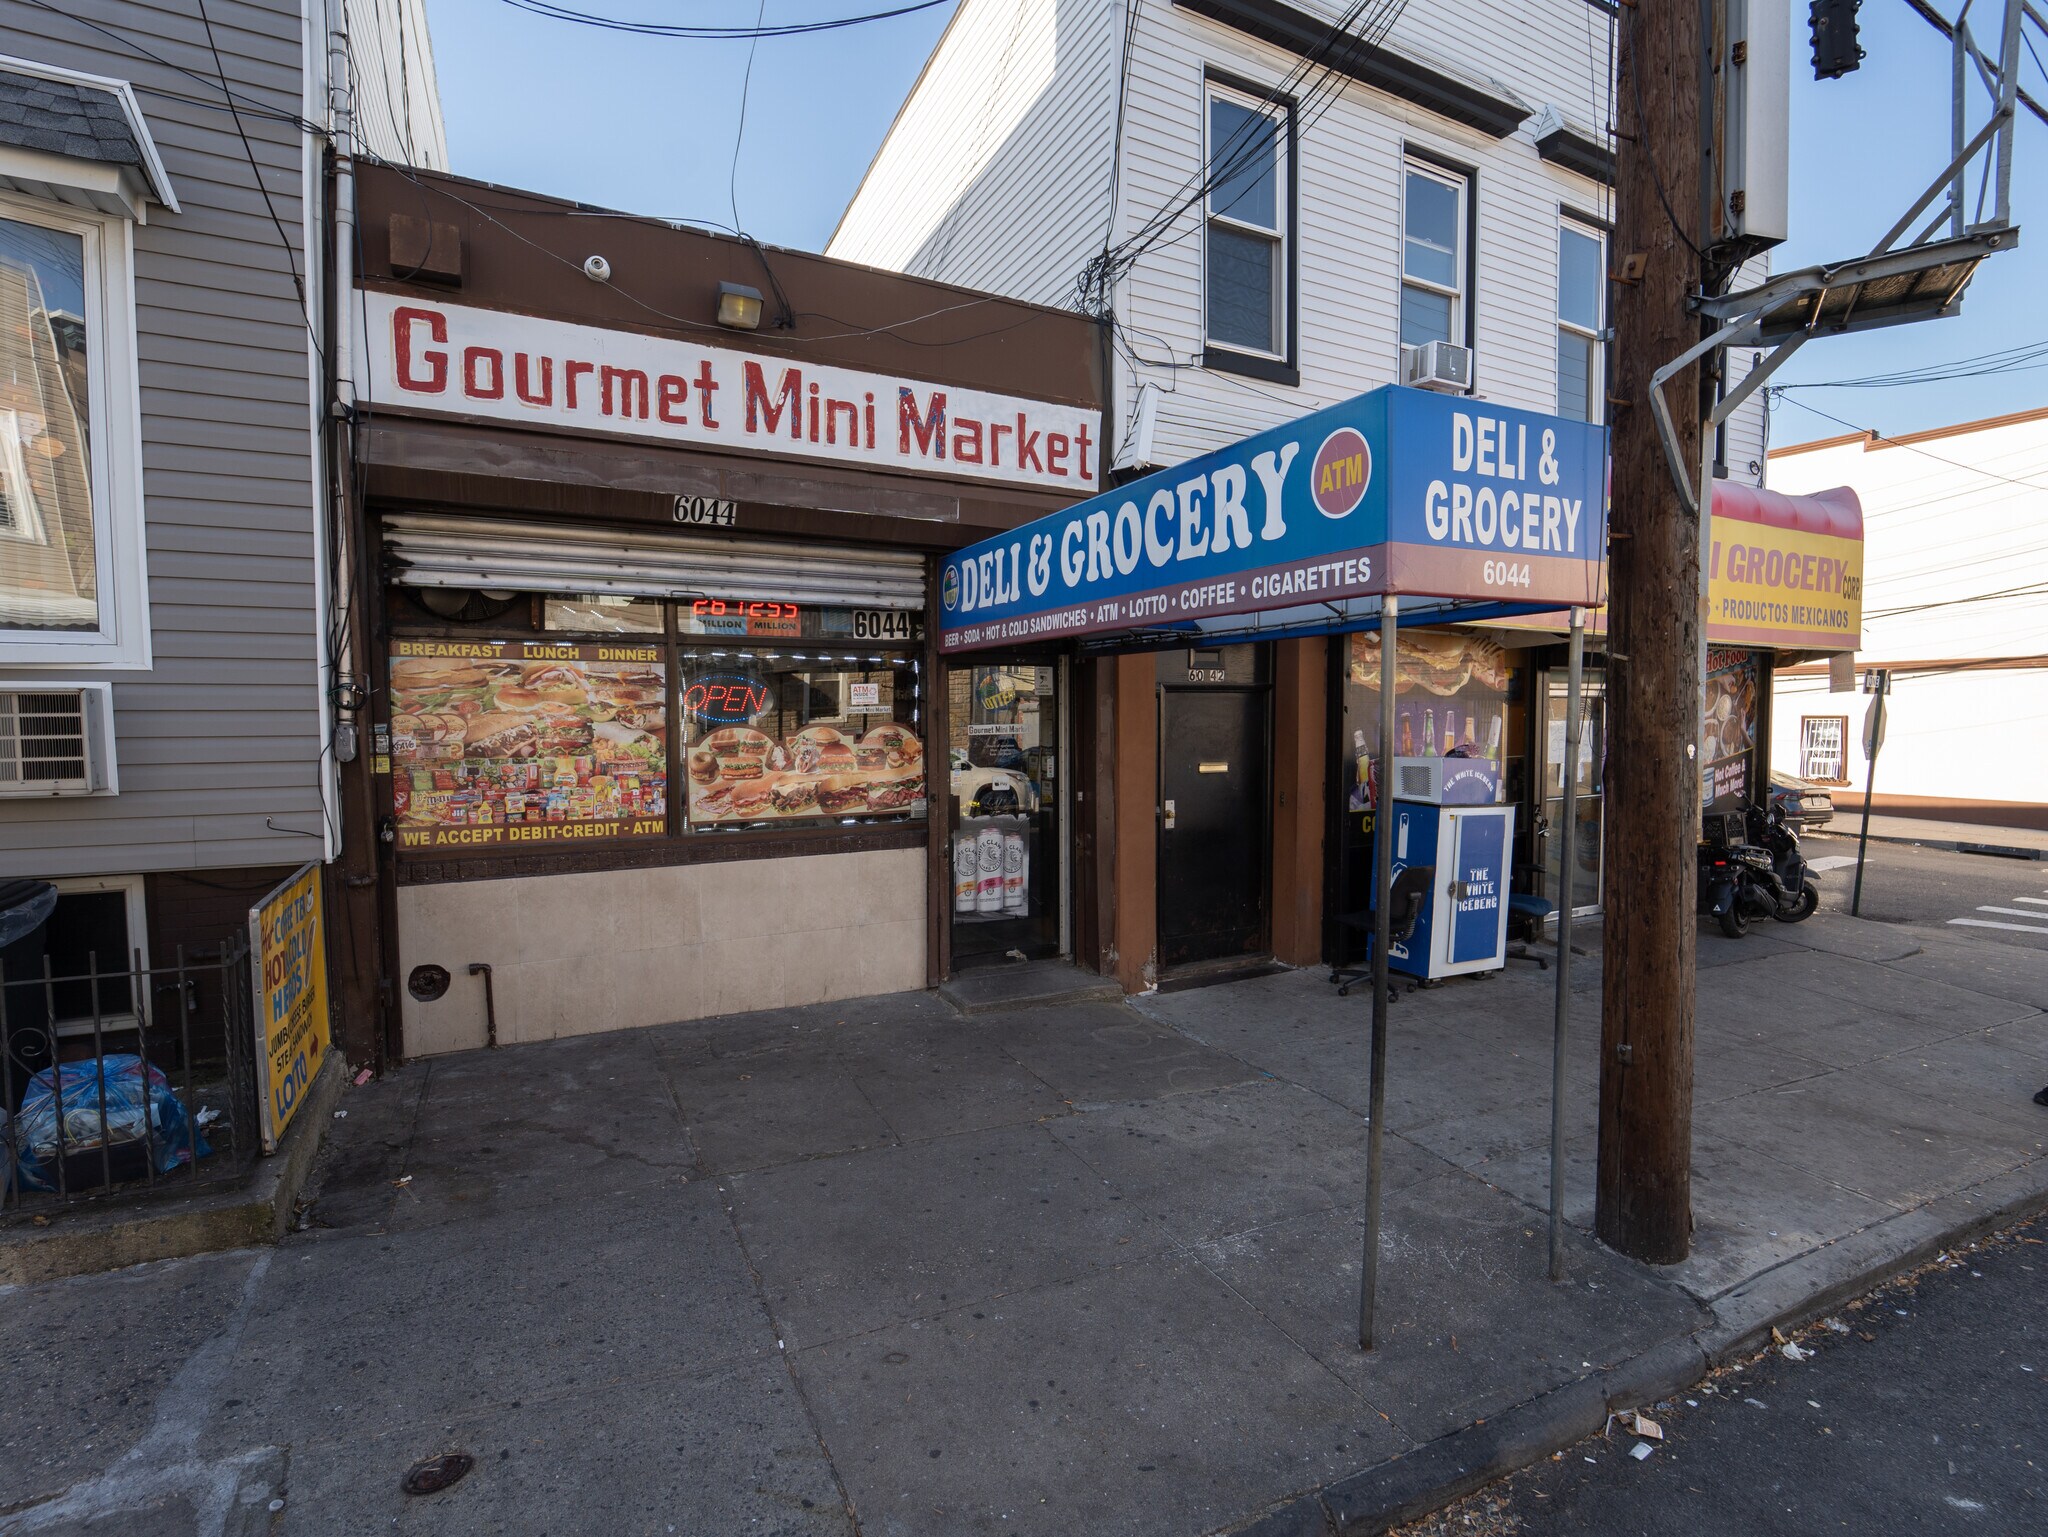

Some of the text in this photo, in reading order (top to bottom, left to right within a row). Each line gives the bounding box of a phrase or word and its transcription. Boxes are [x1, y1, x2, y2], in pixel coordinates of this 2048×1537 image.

[393, 307, 1093, 481] Gourmet Mini Market
[1453, 412, 1559, 485] DELI &
[1320, 453, 1362, 495] ATM
[674, 496, 736, 526] 6044
[1425, 480, 1582, 552] GROCERY
[961, 542, 1020, 612] DELI
[1028, 534, 1052, 597] &
[1060, 441, 1300, 588] GROCERY
[1484, 560, 1530, 588] 6044
[1727, 543, 1848, 593] GROCERY
[945, 632, 959, 647] BEER
[964, 628, 980, 644] SODA
[986, 625, 1000, 641] HOT
[1008, 615, 1028, 638] COLD
[1030, 609, 1087, 633] SANDWICHES
[1096, 602, 1118, 623] ATM
[1129, 598, 1167, 619] LOTTO
[1180, 582, 1235, 610] COFFEE
[1251, 557, 1371, 599] CIGARETTES
[1723, 598, 1788, 623] PRODUCTOS
[1792, 604, 1849, 628] MEXICANOS
[754, 621, 796, 630] MILLION
[854, 611, 909, 639] 6044
[400, 643, 658, 662] BREAKFAST LUNCH DINNER
[1724, 649, 1748, 668] Food
[683, 684, 767, 712] OPEN
[969, 726, 994, 734] Gourmet
[1444, 769, 1494, 792] THE WHITE ICEBERG
[404, 831, 431, 846] WE
[436, 828, 504, 845] ACCEPT
[633, 821, 664, 834] ATM
[1470, 867, 1488, 881] THE
[1459, 896, 1497, 912] ICEBERG
[265, 949, 286, 994] HOT
[275, 1050, 308, 1121] LOTTO
